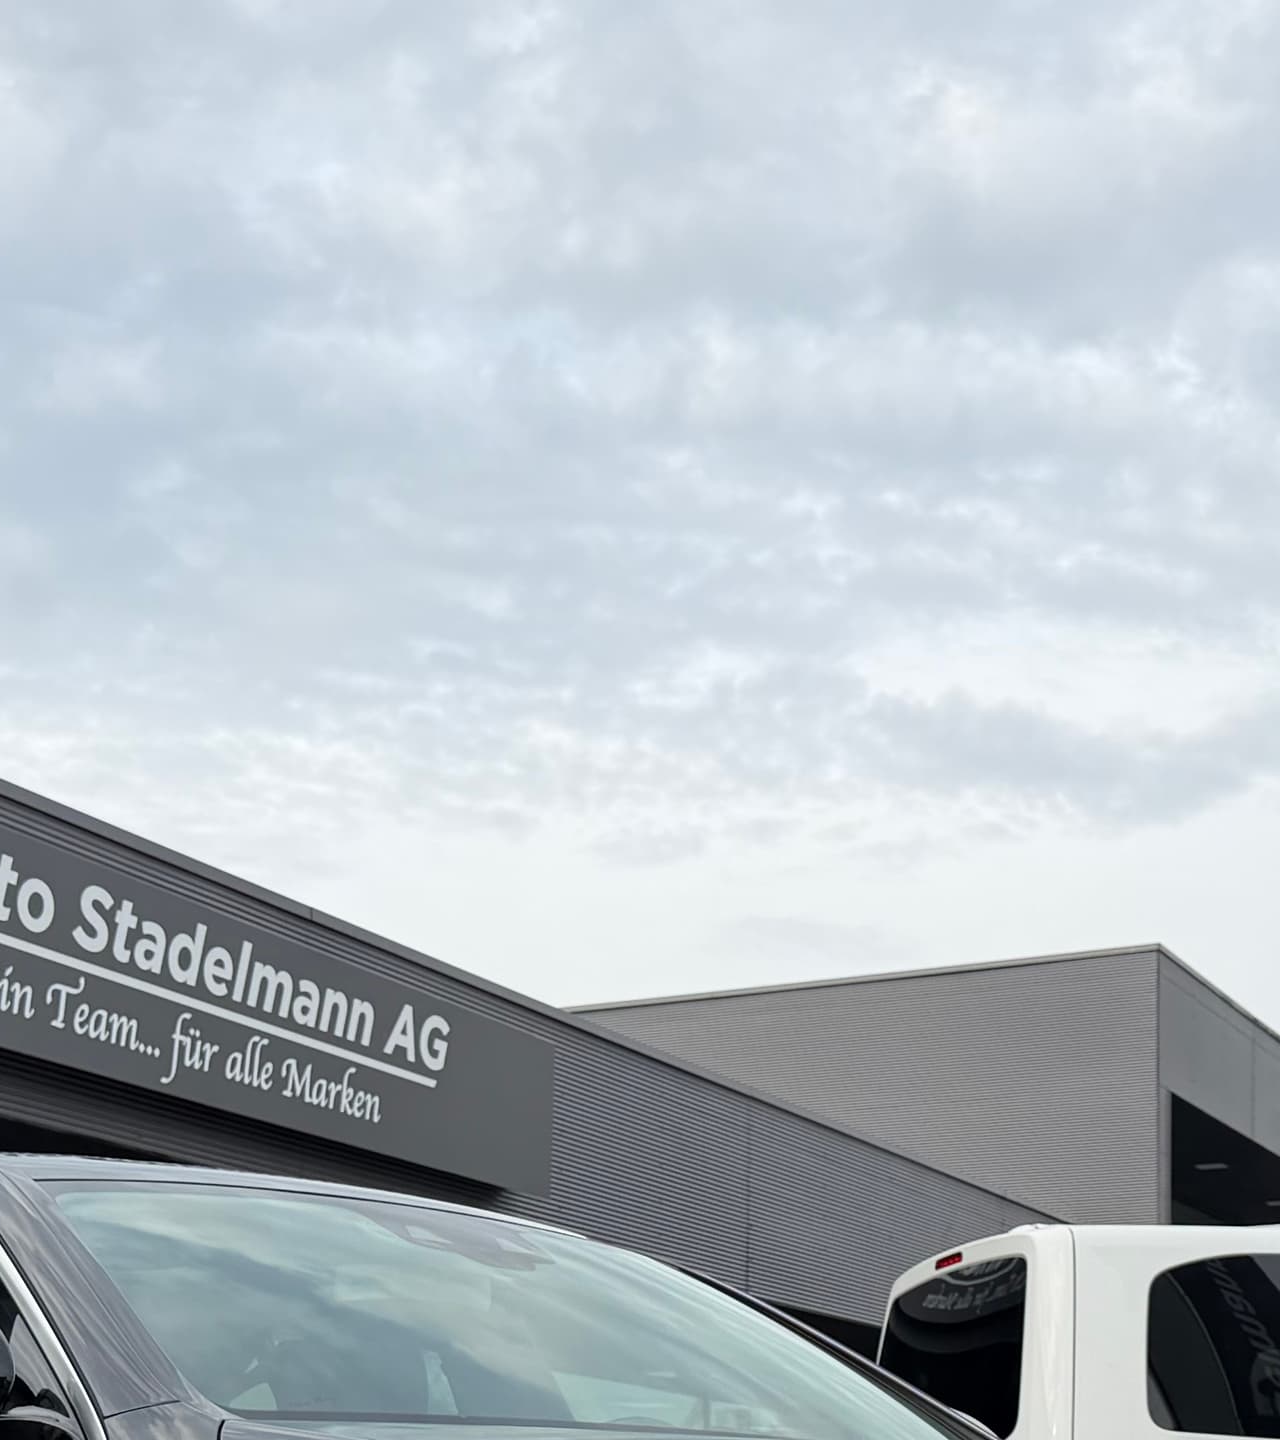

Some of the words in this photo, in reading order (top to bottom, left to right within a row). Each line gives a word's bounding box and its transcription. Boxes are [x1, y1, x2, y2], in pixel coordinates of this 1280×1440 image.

[45, 975, 161, 1058] Team...
[160, 1011, 220, 1084] für
[225, 1035, 274, 1091] alle
[280, 1056, 382, 1124] Marken
[72, 885, 375, 1047] Stadelmann
[383, 1003, 451, 1071] AG
